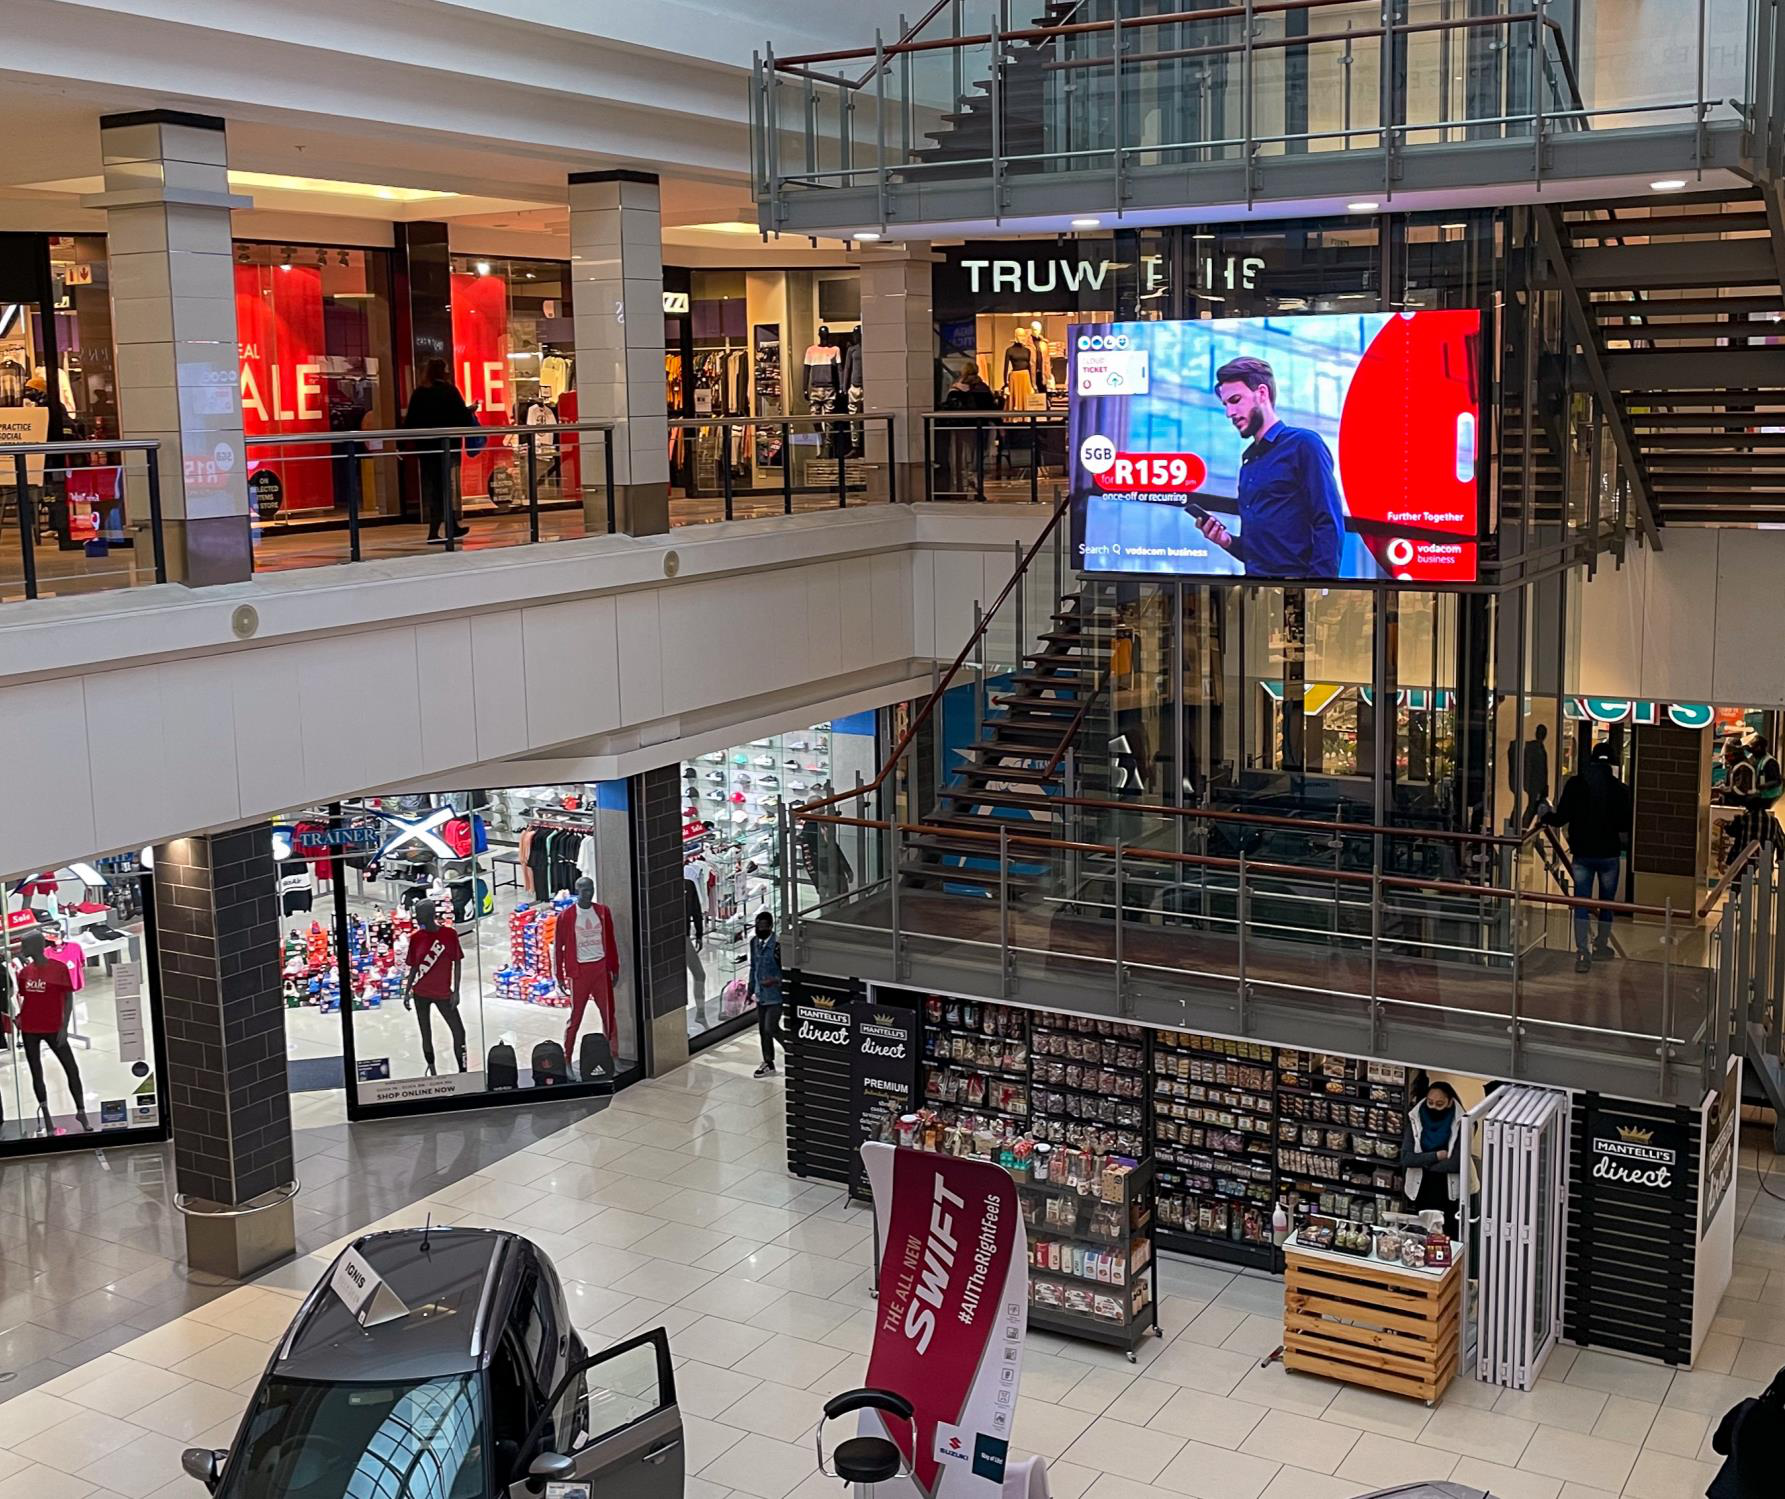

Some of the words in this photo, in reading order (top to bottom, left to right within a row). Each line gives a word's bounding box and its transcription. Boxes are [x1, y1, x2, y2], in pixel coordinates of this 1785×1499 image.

[241, 361, 322, 421] ALE
[1084, 447, 1113, 460] 5GB
[1101, 474, 1114, 484] for
[1115, 459, 1188, 485] R159
[1102, 491, 1137, 501] once-off
[1138, 493, 1147, 501] or
[1148, 492, 1187, 504] recurring
[1387, 511, 1421, 521] Further
[1423, 511, 1464, 523] Together
[1078, 543, 1110, 555] Search
[1125, 546, 1166, 556] vodacom
[1167, 546, 1208, 557] business
[1417, 544, 1462, 553] vodacom
[1417, 554, 1456, 564] business
[299, 828, 377, 847] TRAINER
[12, 913, 31, 924] Sale
[800, 1008, 848, 1023] MANTELLI'S
[798, 1020, 850, 1045] direct
[863, 1025, 905, 1038] MANTELLI'S
[861, 1037, 906, 1059] direct
[377, 1091, 400, 1100] SHOP
[402, 1088, 433, 1098] ONLINE
[434, 1086, 456, 1095] NOW
[863, 1077, 909, 1094] PREMIUM
[1597, 1141, 1671, 1161] MANTELLI'S
[1592, 1156, 1672, 1188] direct
[903, 1234, 922, 1270] NEW
[957, 1194, 1001, 1325] #AllTheRightFeels
[904, 1171, 965, 1356] SWIFT
[345, 1261, 366, 1289] IGNIS
[895, 1274, 914, 1302] ALL
[882, 1301, 904, 1333] THE
